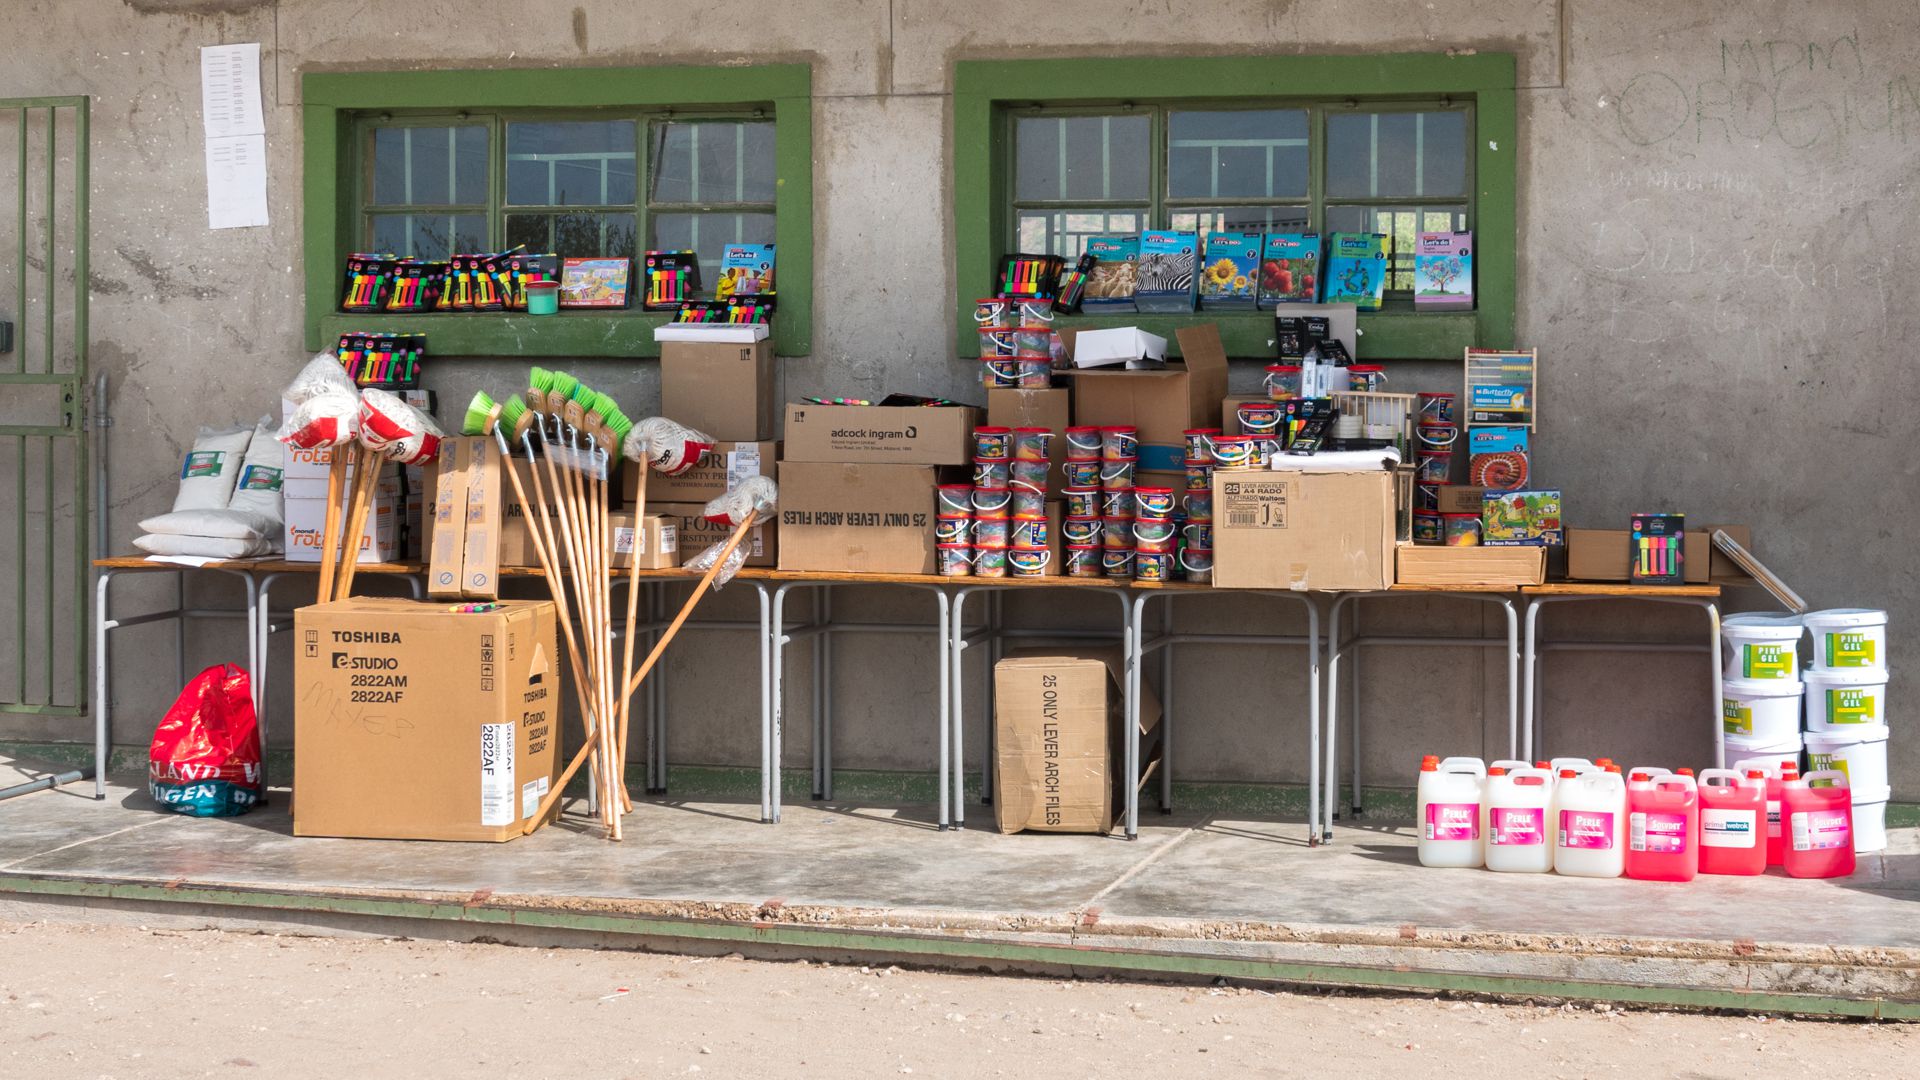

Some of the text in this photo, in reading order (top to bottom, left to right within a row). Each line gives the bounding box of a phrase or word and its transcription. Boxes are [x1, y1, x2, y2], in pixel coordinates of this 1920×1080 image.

[1482, 388, 1514, 396] Butterfly
[831, 428, 903, 440] adcock ingram
[1225, 484, 1239, 493] 25
[783, 510, 927, 527] 25 ONLY LEVER ARCH FILES
[332, 631, 402, 644] TOSHIBA
[1840, 635, 1864, 643] PINE
[1758, 646, 1782, 655] PINE
[1843, 642, 1861, 651] GEL
[1761, 654, 1779, 663] GEL
[351, 675, 408, 688] 2822AM
[351, 690, 404, 703] 2822AF
[523, 688, 547, 703] TOSHIBA
[1840, 691, 1863, 700] PINE
[1843, 699, 1861, 707] GEL
[482, 725, 494, 776] 2822AF
[1043, 675, 1061, 826] 25 ONLY LEVER ARCH FILES
